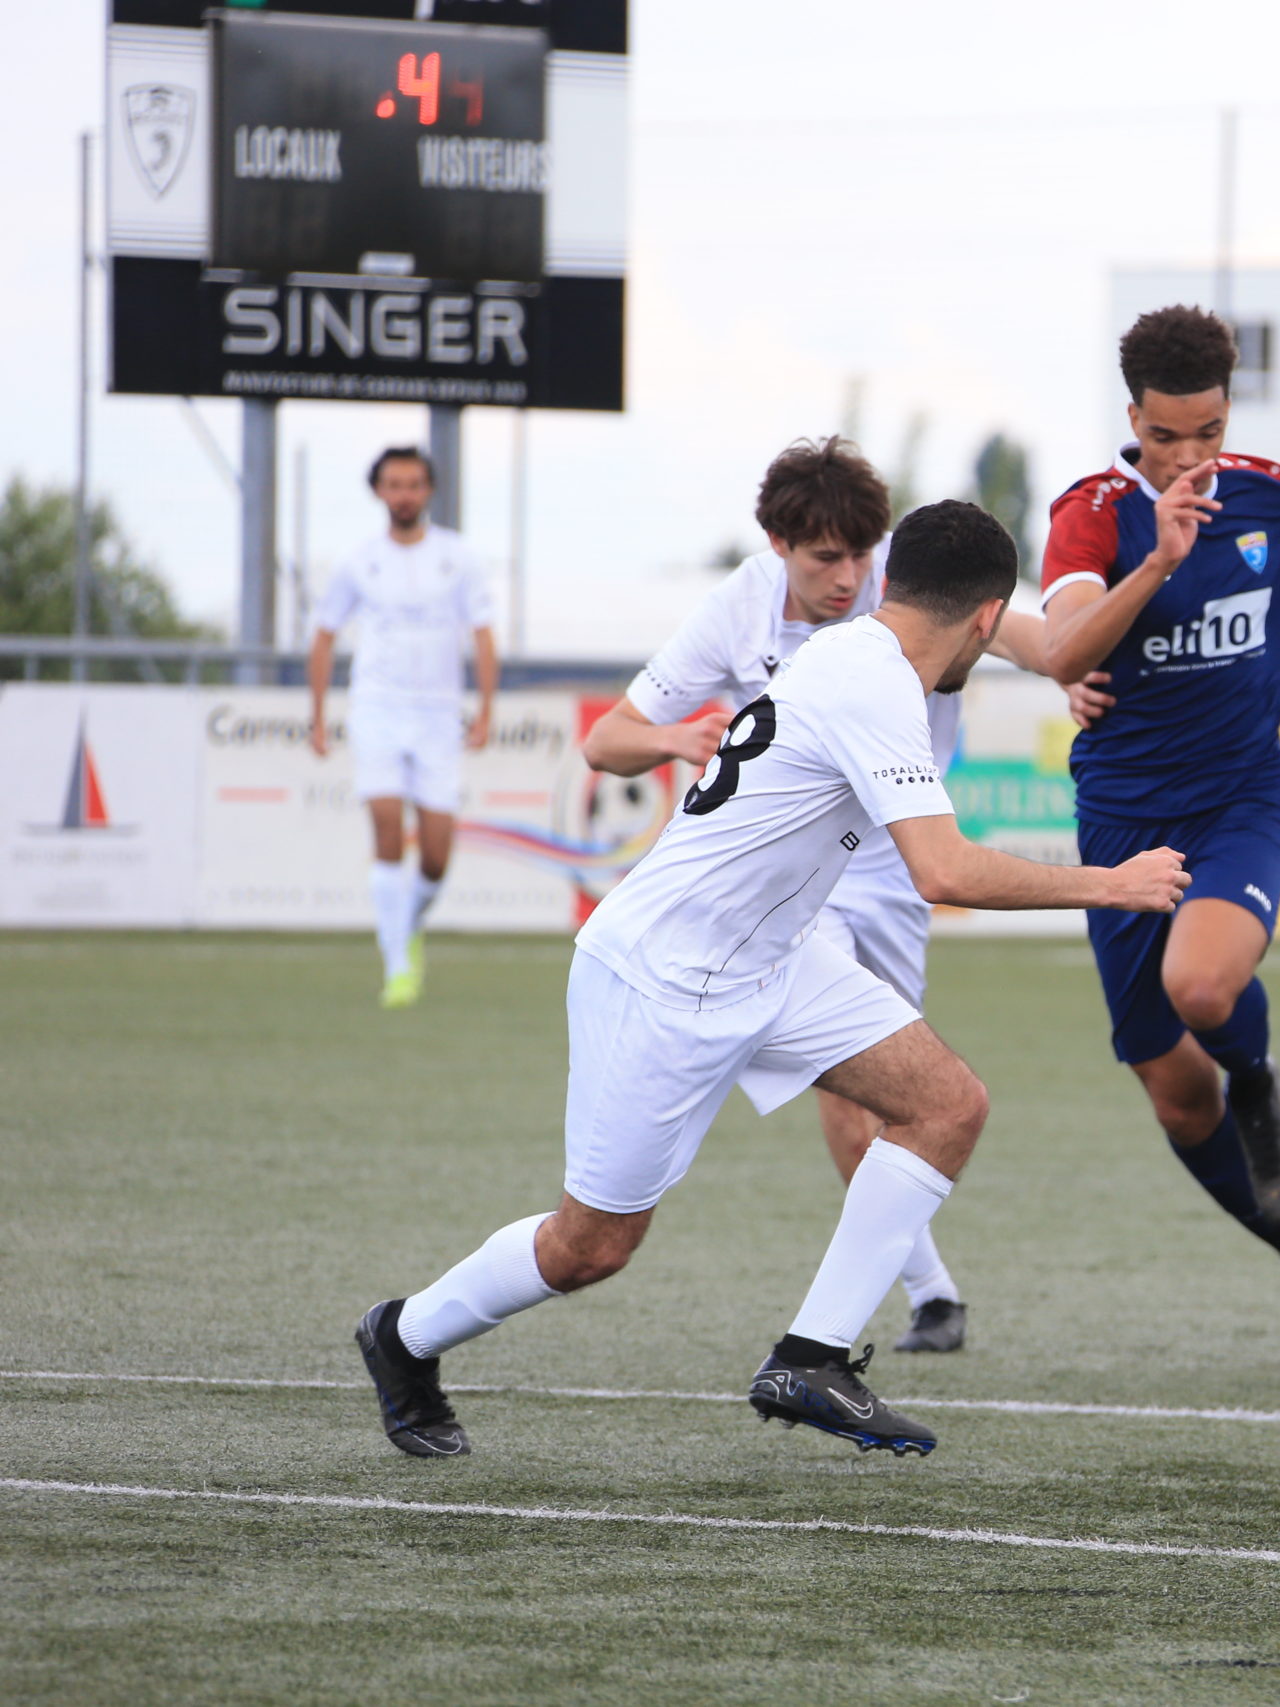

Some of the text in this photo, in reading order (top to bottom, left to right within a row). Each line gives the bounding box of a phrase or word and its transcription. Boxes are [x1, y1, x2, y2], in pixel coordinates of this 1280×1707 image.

[234, 125, 342, 182] LOCAUX
[221, 285, 530, 366] SINGER
[1143, 612, 1251, 663] eli10
